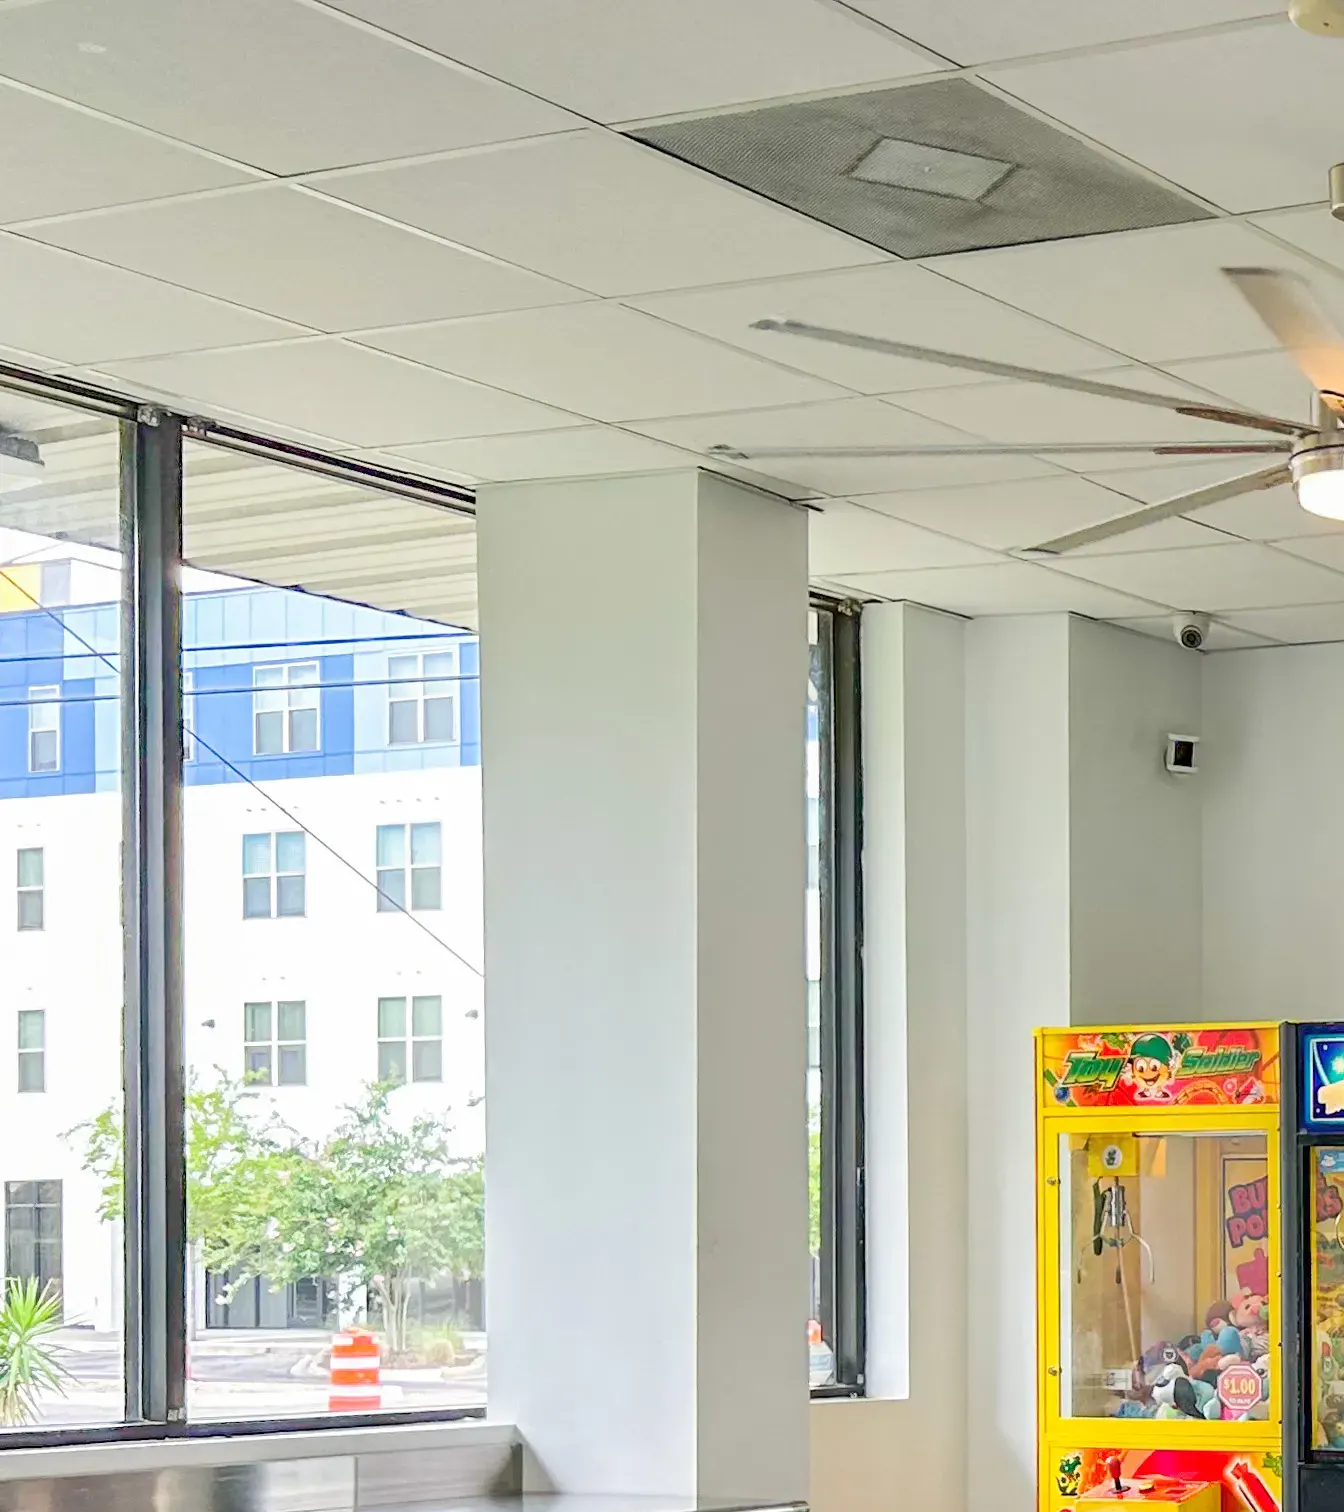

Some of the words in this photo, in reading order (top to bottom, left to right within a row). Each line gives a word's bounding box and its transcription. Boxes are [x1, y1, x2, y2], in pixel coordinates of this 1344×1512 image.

[1062, 1051, 1129, 1091] Toy
[1174, 1047, 1261, 1079] Soldier
[1228, 1177, 1268, 1214] BU
[1226, 1210, 1268, 1249] PO
[1223, 1378, 1256, 1395] $1.00
